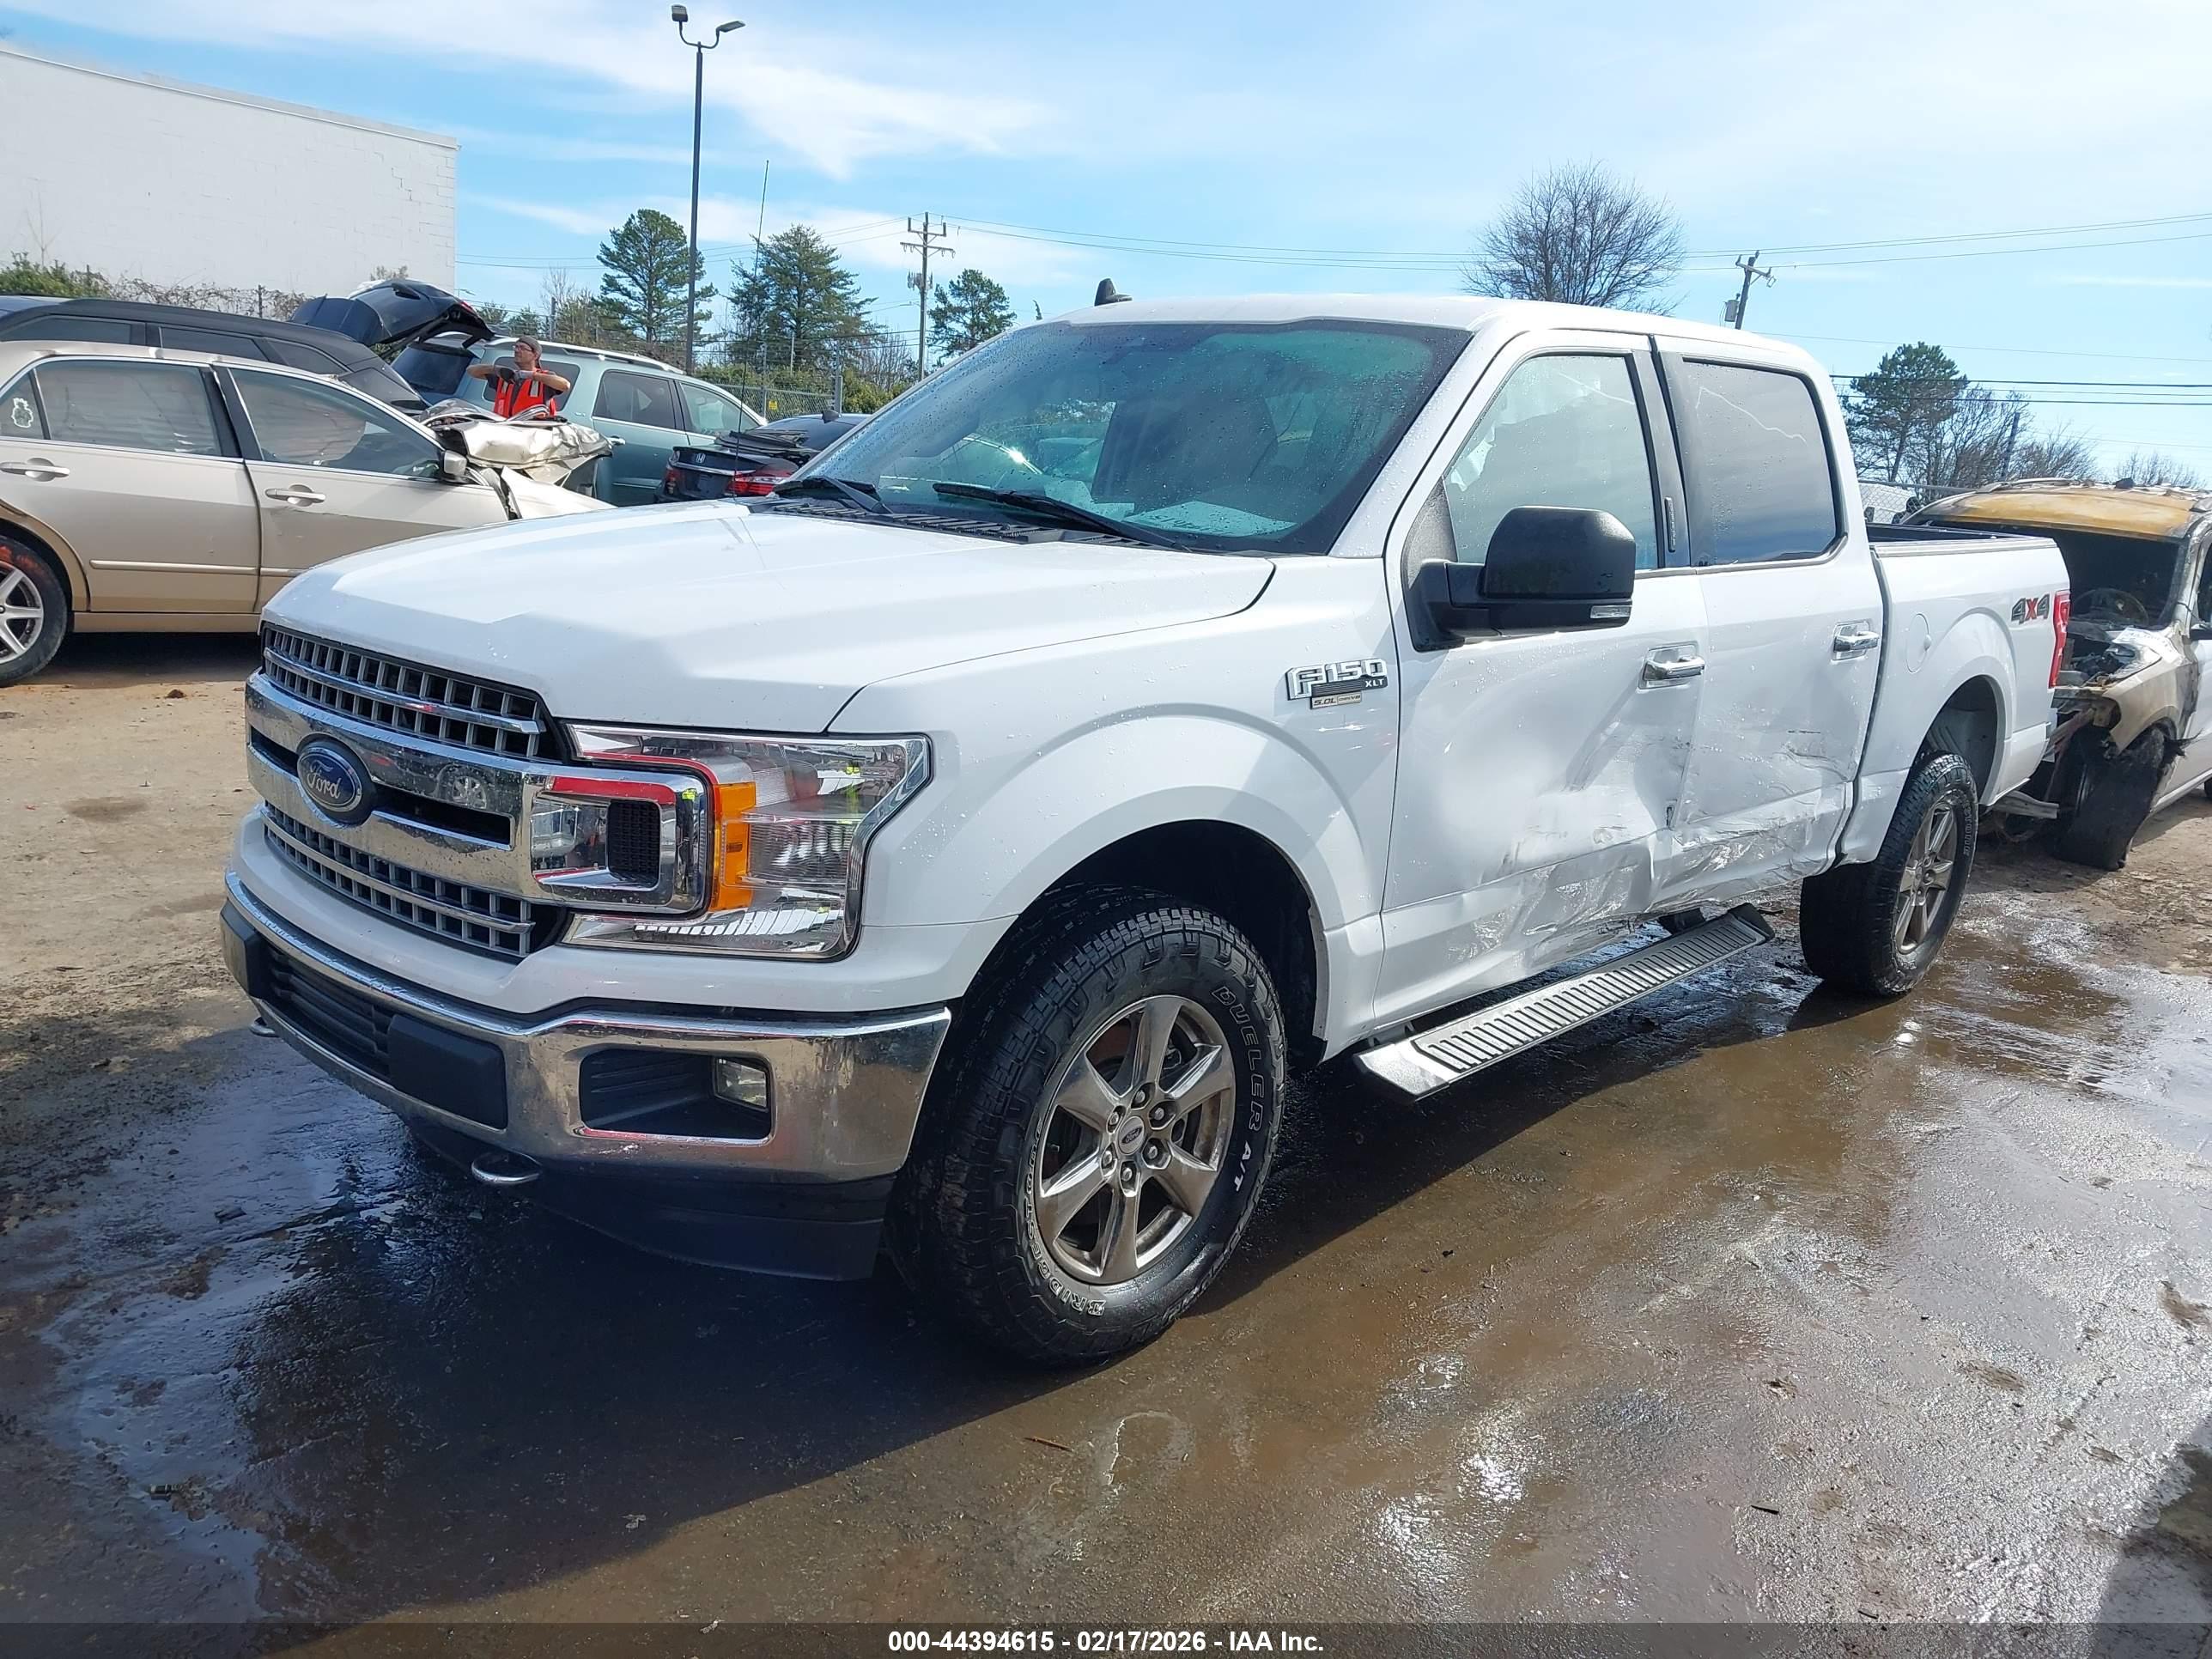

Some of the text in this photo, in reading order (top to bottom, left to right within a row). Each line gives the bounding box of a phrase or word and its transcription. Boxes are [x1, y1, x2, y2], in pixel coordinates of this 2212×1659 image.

[1313, 697, 1337, 706] 5.0L
[1364, 678, 1384, 688] XLT
[307, 759, 342, 799] Ford
[1212, 986, 1265, 1132] DUELER
[1233, 1140, 1251, 1192] A/T
